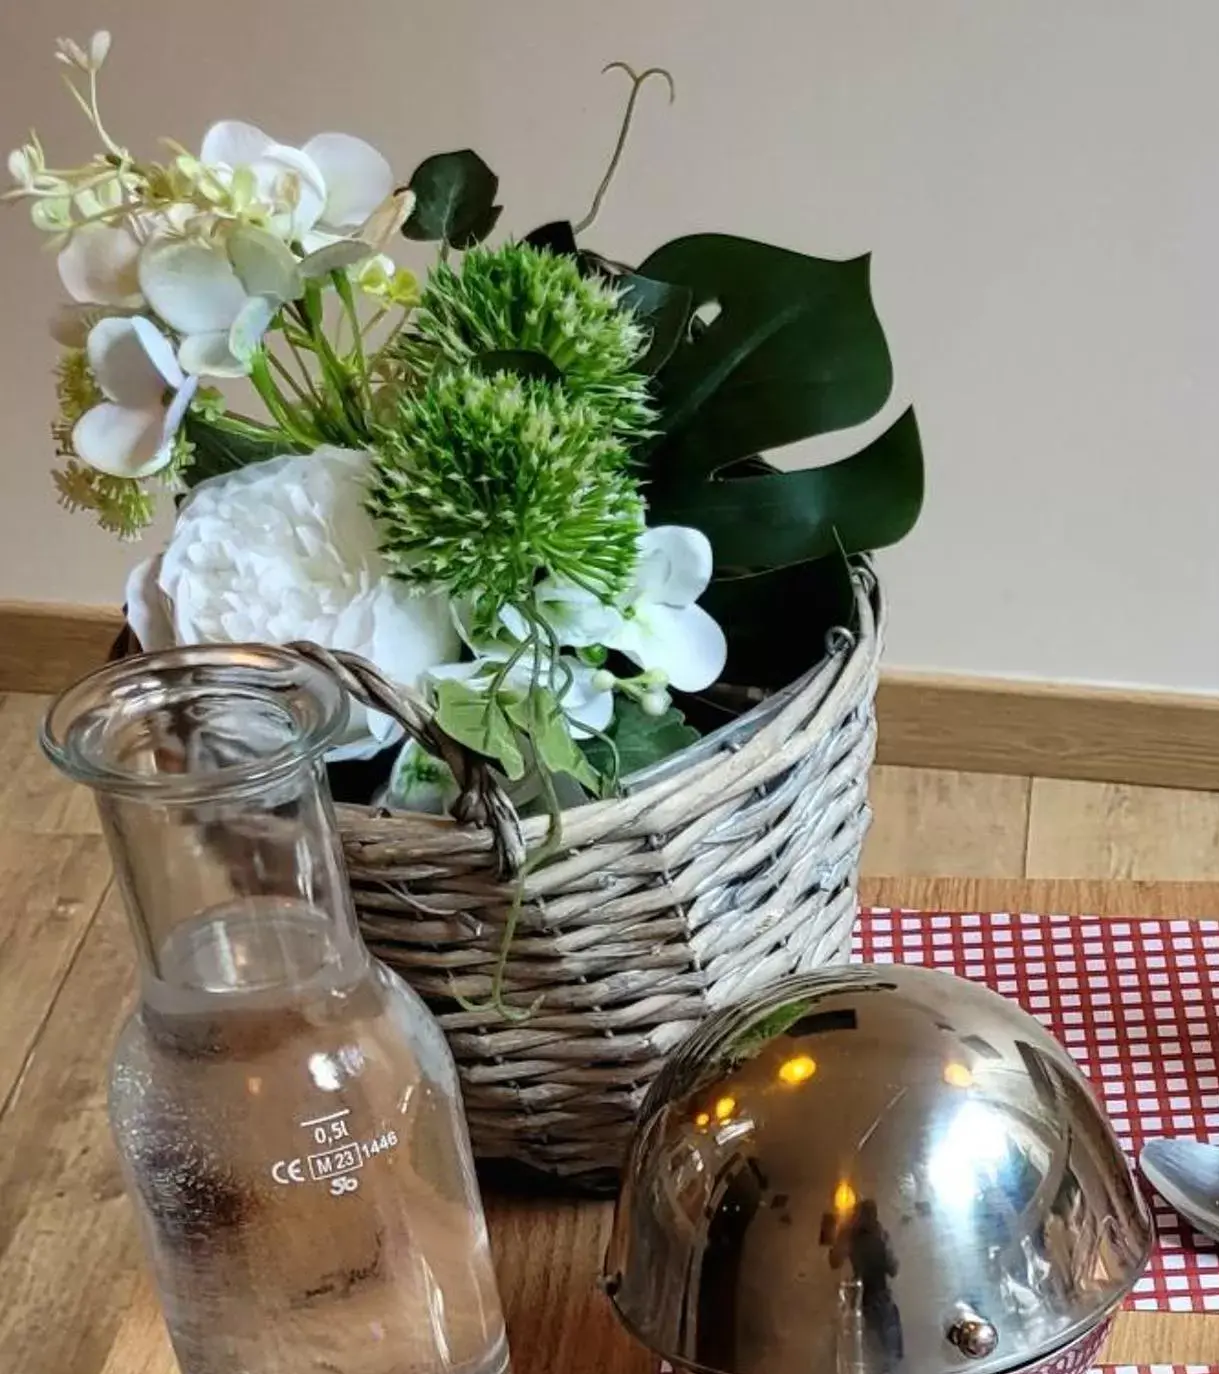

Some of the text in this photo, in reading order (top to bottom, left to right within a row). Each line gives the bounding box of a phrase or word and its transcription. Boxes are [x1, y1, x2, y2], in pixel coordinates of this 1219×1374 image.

[316, 1158, 333, 1175] M
[335, 1151, 355, 1170] 23
[361, 1131, 398, 1159] 1446
